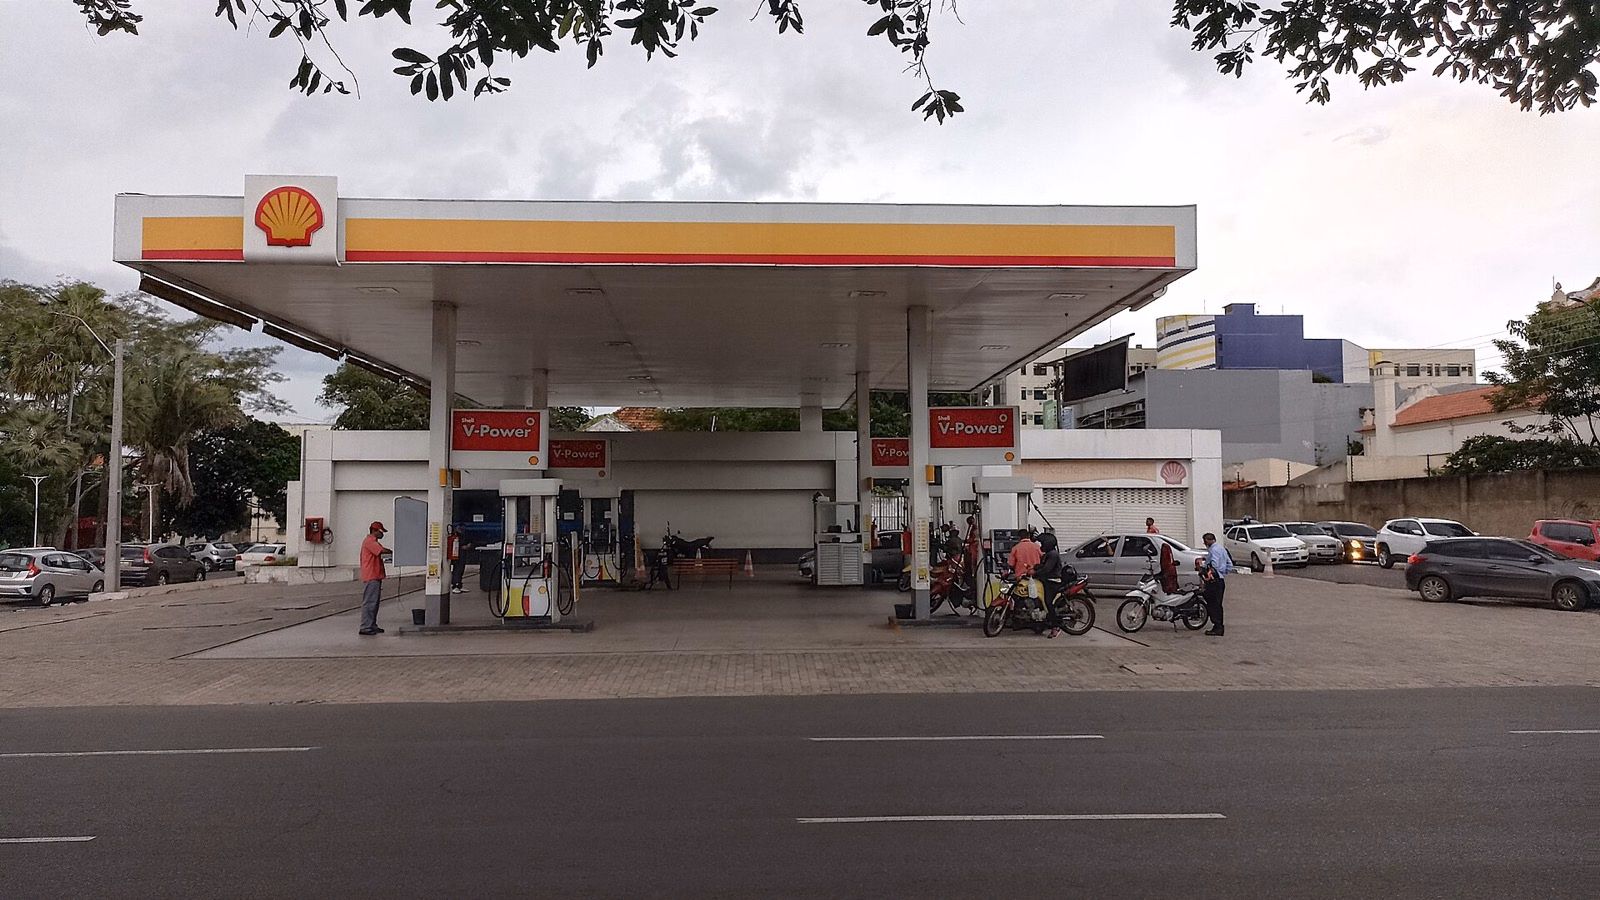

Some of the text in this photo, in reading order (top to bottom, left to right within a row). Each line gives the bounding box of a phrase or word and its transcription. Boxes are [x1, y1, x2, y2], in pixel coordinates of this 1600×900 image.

[463, 424, 532, 438] V-Power
[938, 422, 1005, 435] V-Power
[553, 449, 600, 458] V-Power
[878, 448, 909, 457] V-Pow
